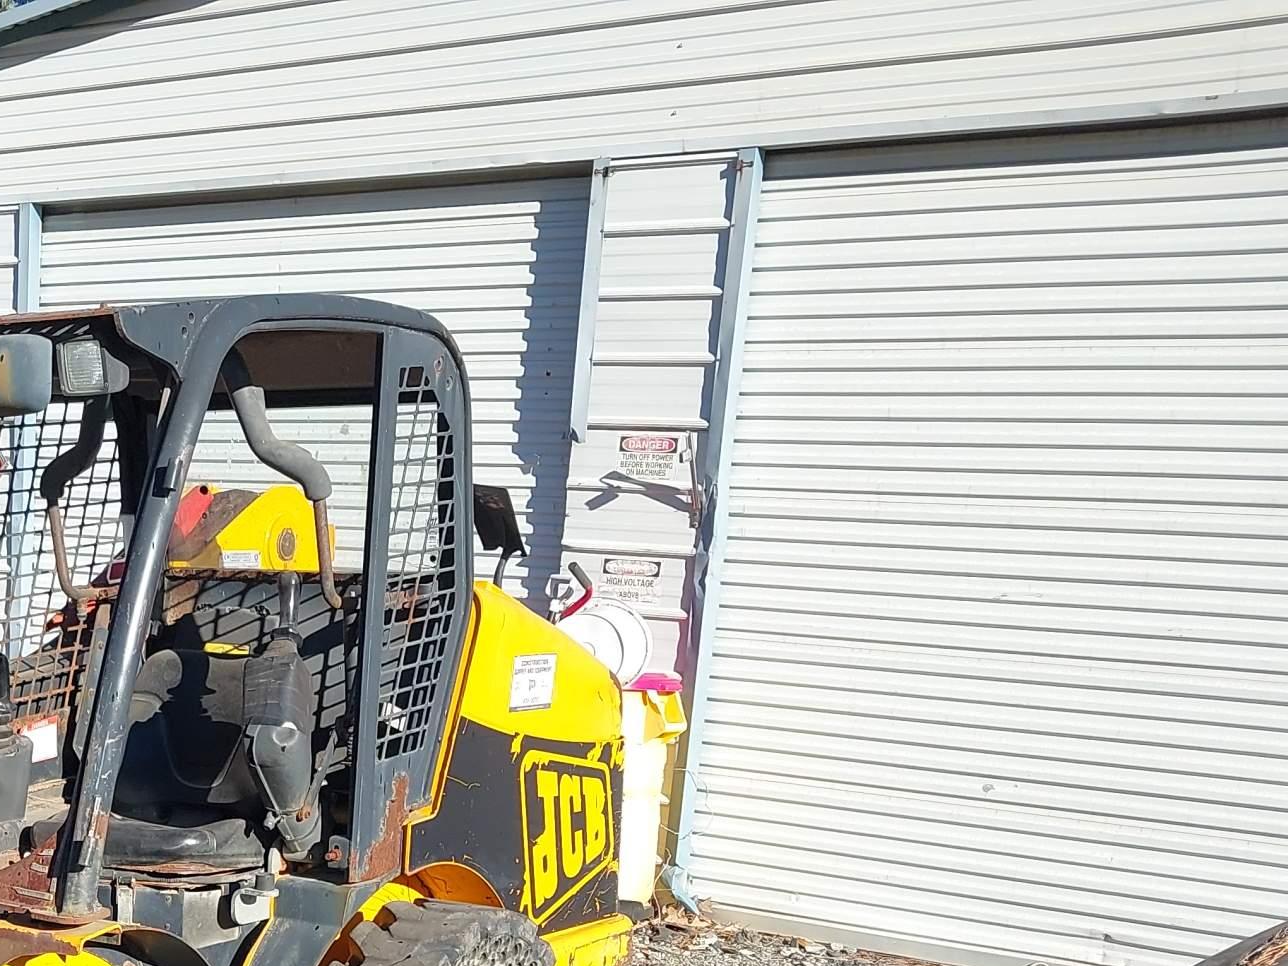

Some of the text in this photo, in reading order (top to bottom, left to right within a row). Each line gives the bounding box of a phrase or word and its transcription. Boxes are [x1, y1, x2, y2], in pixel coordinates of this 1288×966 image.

[628, 440, 669, 450] DANGER
[622, 453, 637, 461] TURN
[651, 454, 674, 462] POWER
[645, 461, 673, 470] WORKING
[625, 468, 667, 477] ON MACHINES
[606, 577, 655, 588] HIGH VOLTAGE
[532, 769, 606, 909] JCB
